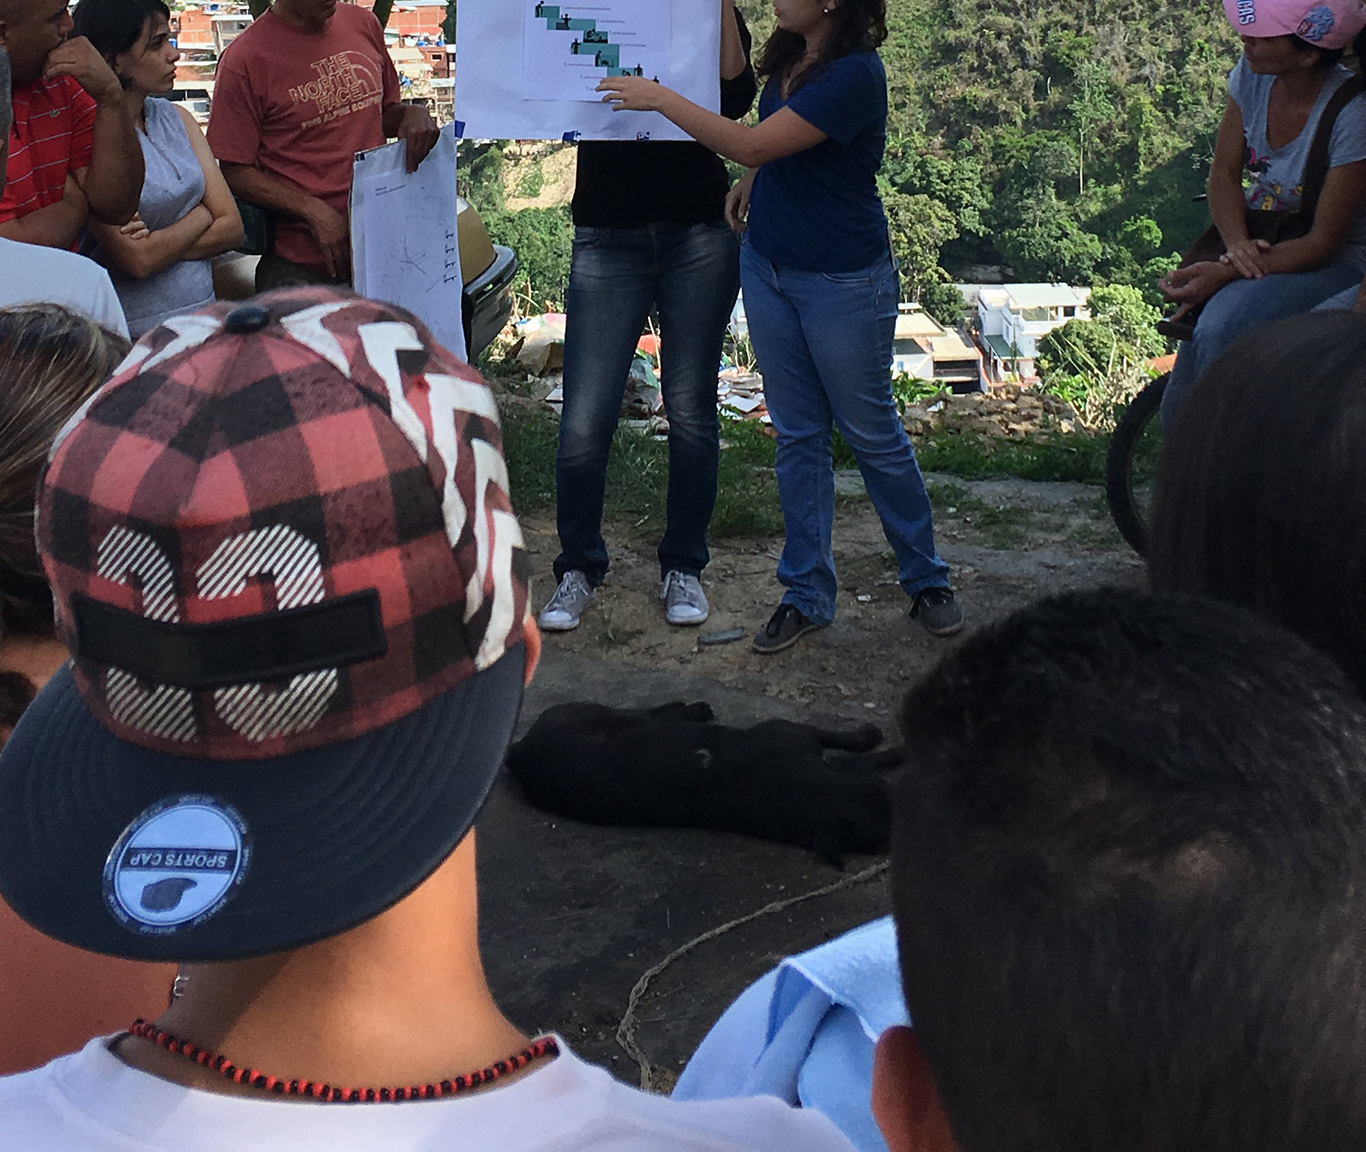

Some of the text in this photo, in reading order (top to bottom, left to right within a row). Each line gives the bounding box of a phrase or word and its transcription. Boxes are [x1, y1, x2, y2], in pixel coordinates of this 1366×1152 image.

[310, 52, 351, 77] THE
[288, 67, 357, 106] NORTH
[316, 84, 363, 114] FACE
[129, 852, 228, 868] SPORTS CAP
